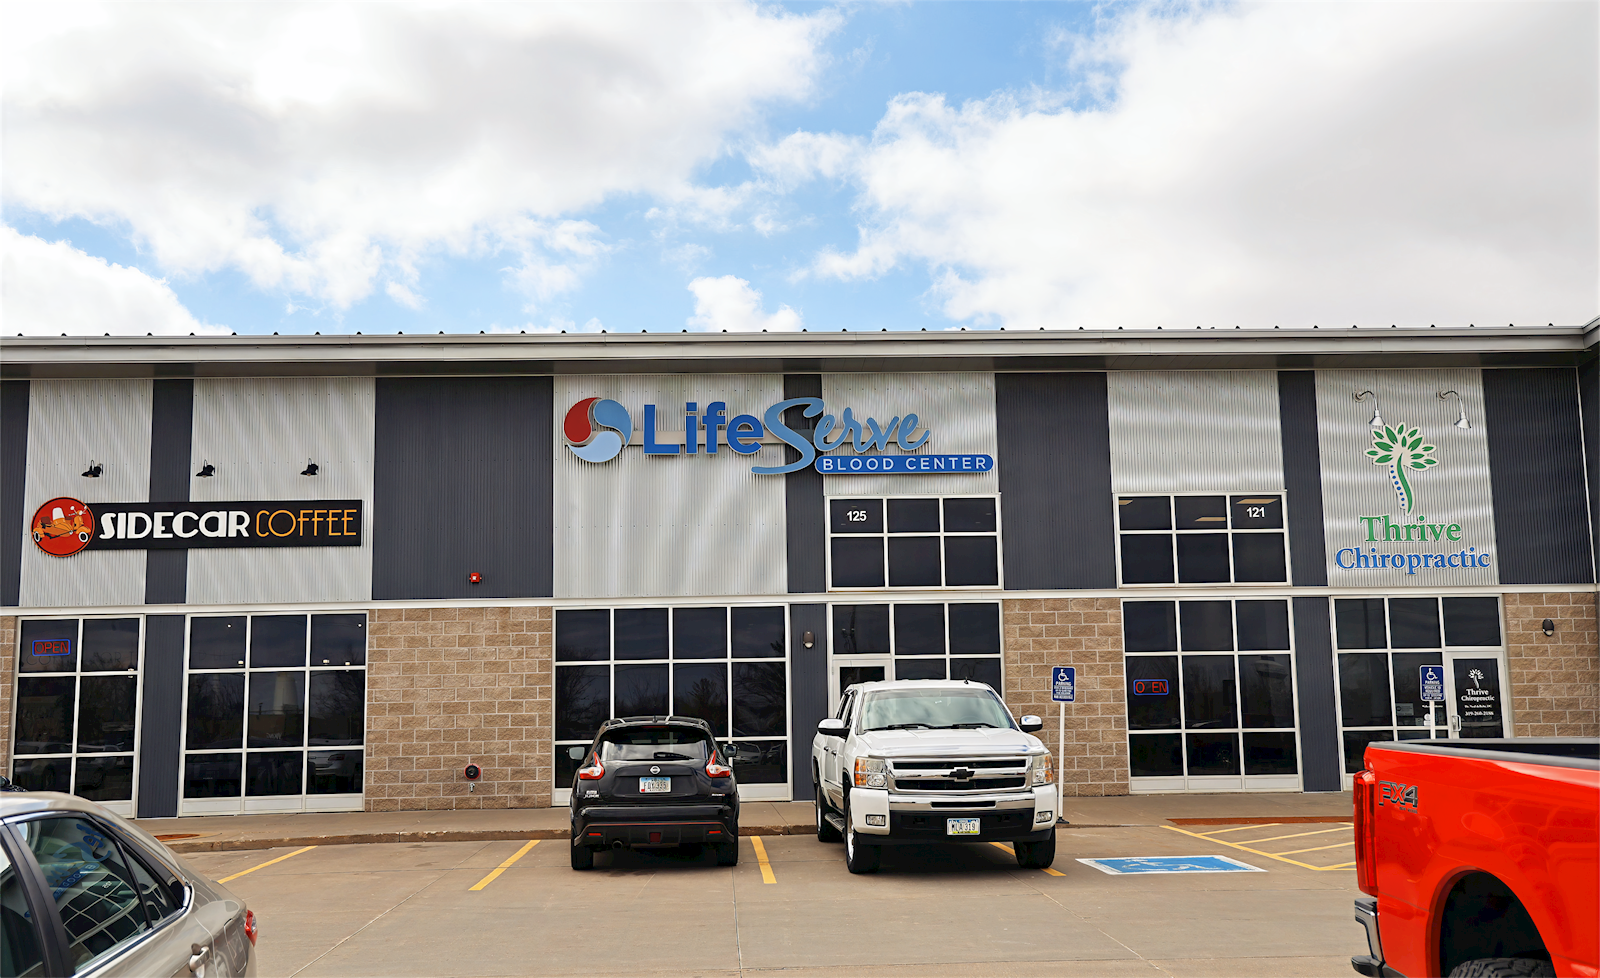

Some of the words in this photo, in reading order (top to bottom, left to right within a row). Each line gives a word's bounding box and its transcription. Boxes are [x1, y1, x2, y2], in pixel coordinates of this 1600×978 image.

[823, 457, 895, 471] BLOOD
[905, 456, 987, 470] CENTER
[846, 510, 868, 523] 125
[1246, 507, 1266, 518] 121
[256, 509, 358, 538] COFFEE
[1359, 514, 1462, 543] Thrive
[1335, 546, 1491, 575] Chiropractic
[34, 641, 70, 655] OPEN
[1135, 681, 1167, 694] OEN
[1465, 688, 1489, 696] Thrive
[1379, 780, 1418, 808] FX4
